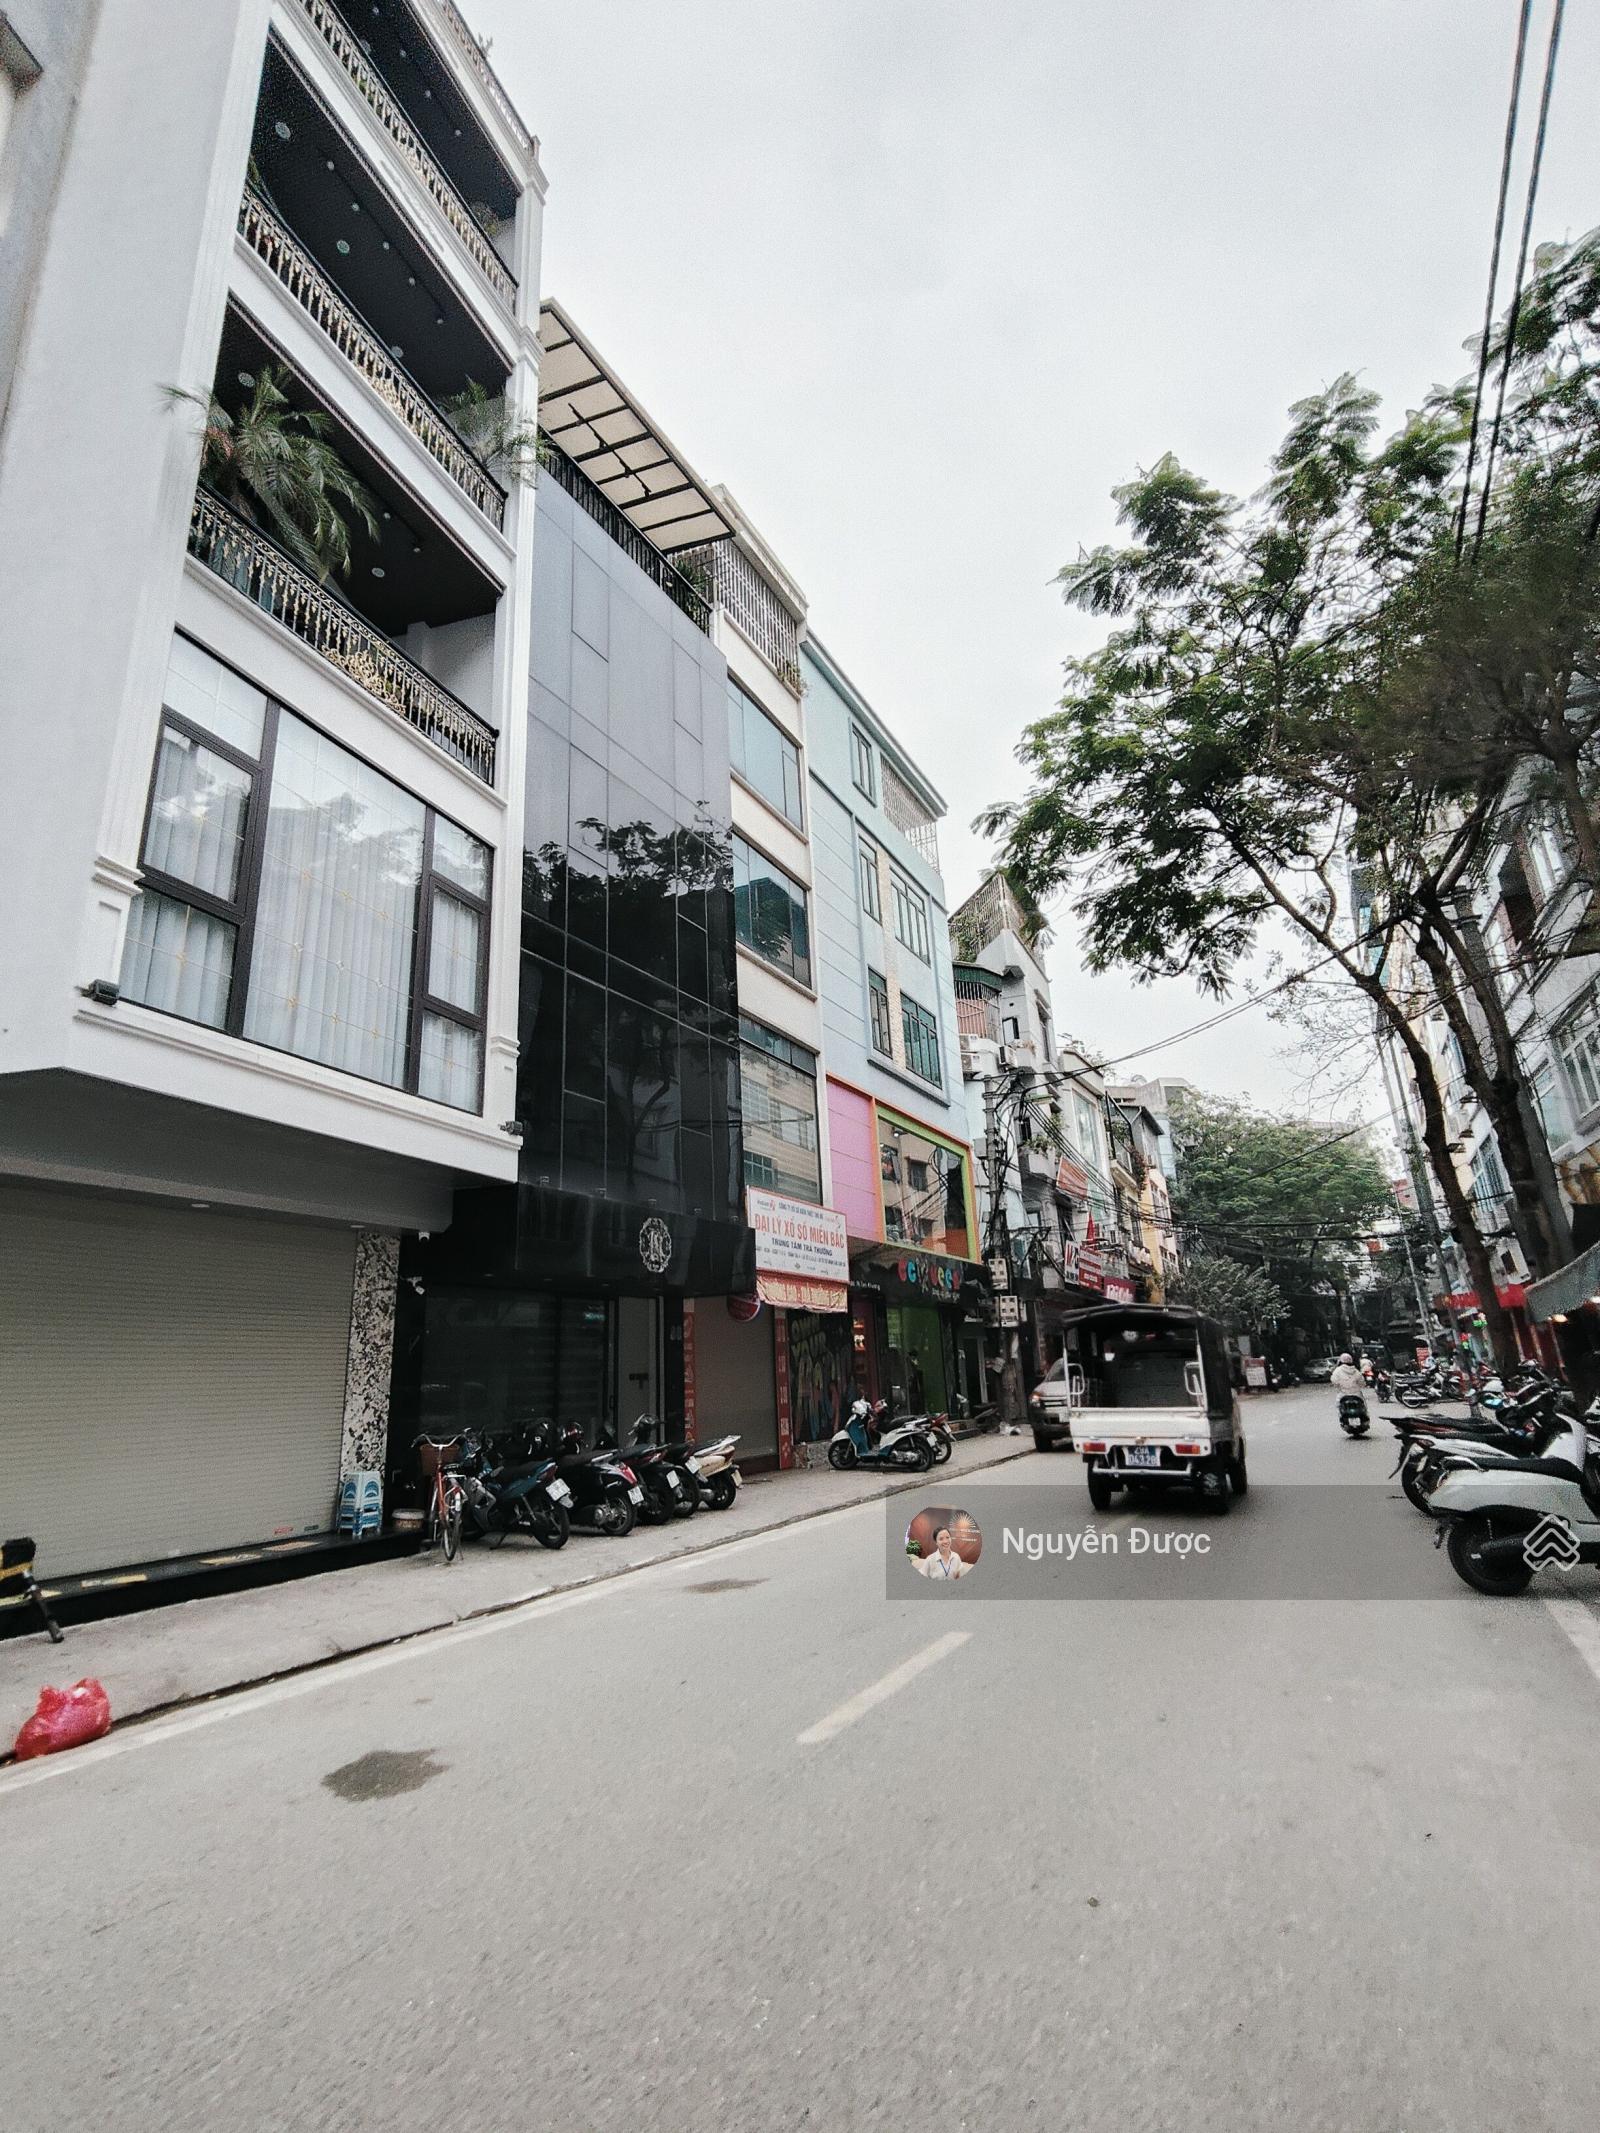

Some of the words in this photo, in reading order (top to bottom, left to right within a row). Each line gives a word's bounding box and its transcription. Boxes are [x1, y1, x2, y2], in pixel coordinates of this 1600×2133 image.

[755, 1213, 770, 1235] ĐẠI
[772, 1215, 782, 1234] LÝ
[784, 1216, 795, 1237] XỔ
[797, 1222, 808, 1241] SỐ
[810, 1224, 829, 1246] MIỀN
[831, 1229, 845, 1249] BẮC
[772, 1238, 790, 1248] TRUNG
[791, 1240, 802, 1251] TÂM
